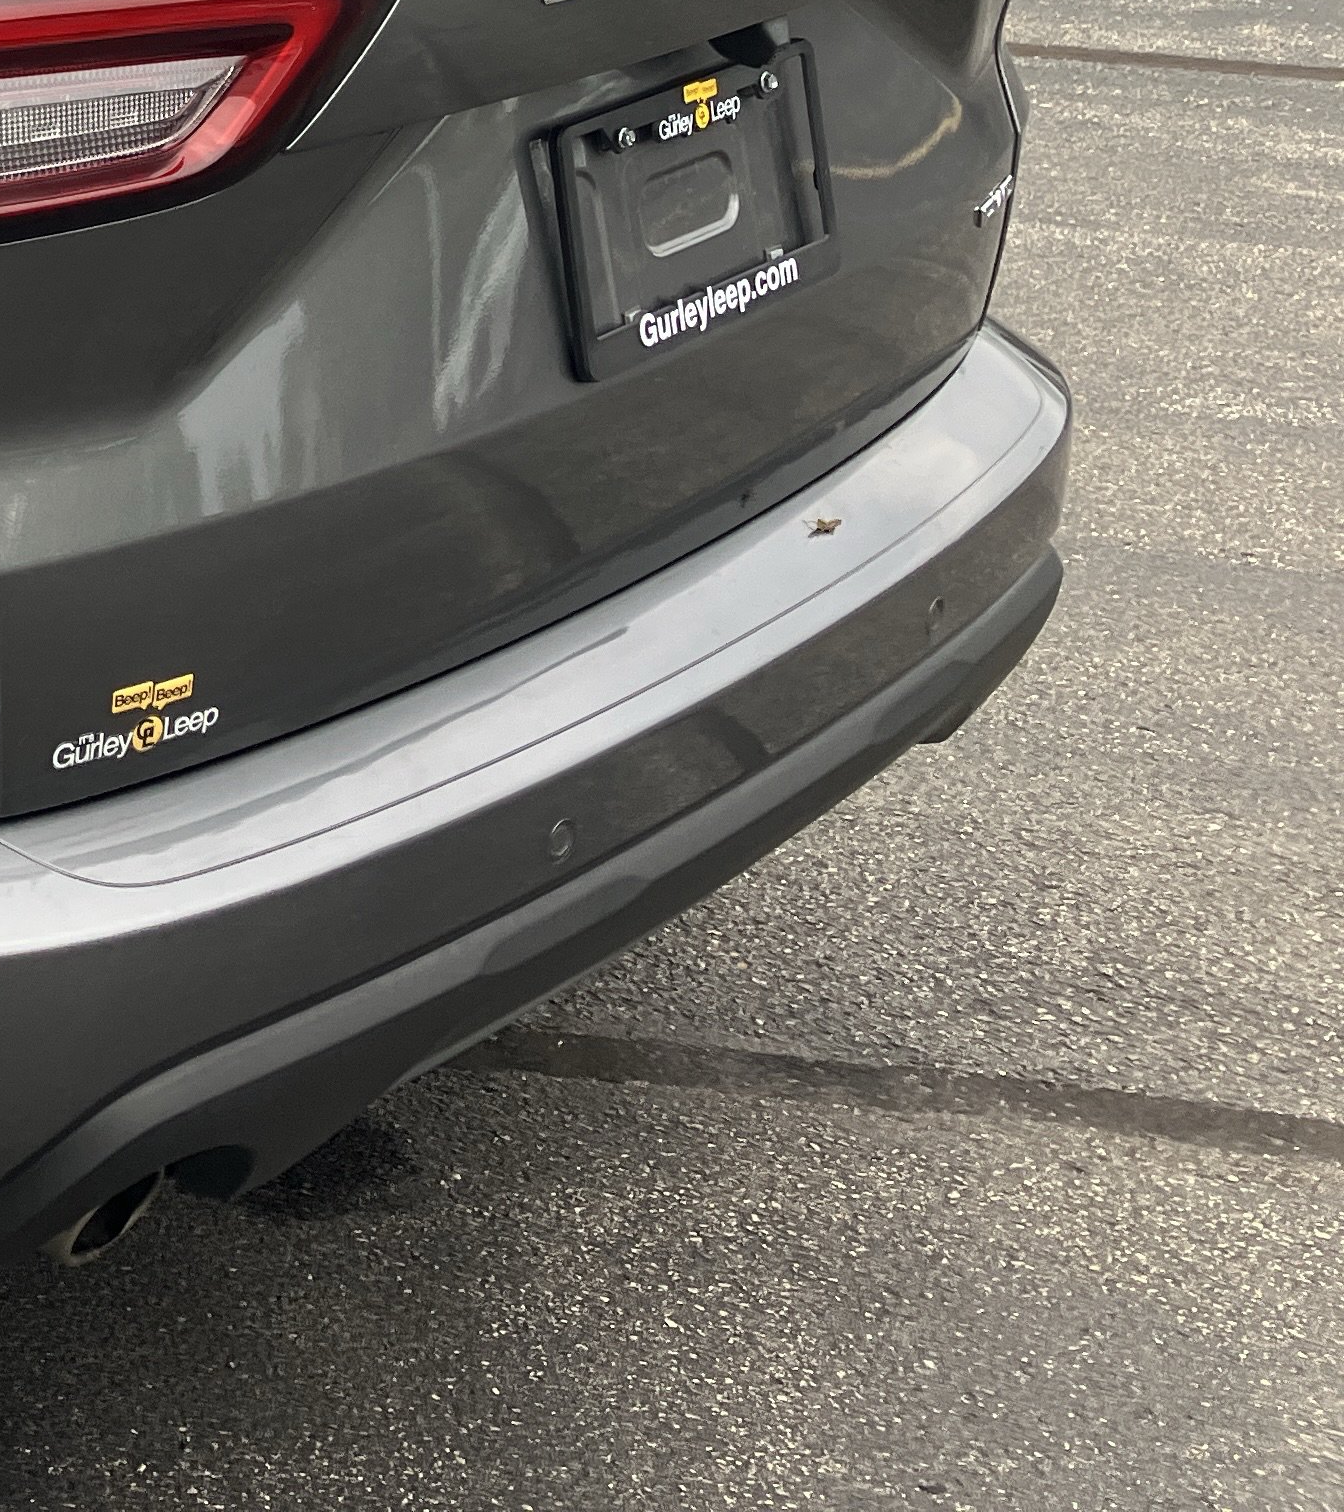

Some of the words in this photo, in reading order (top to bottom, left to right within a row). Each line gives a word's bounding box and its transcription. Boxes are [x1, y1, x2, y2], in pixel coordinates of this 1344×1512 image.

[658, 113, 693, 140] Gurley
[710, 95, 741, 120] Leep
[639, 257, 799, 347] Gurleyleep.com
[114, 685, 152, 707] Beep!
[156, 678, 192, 701] Beep!
[52, 731, 133, 769] Gurley
[163, 706, 219, 740] Leep
